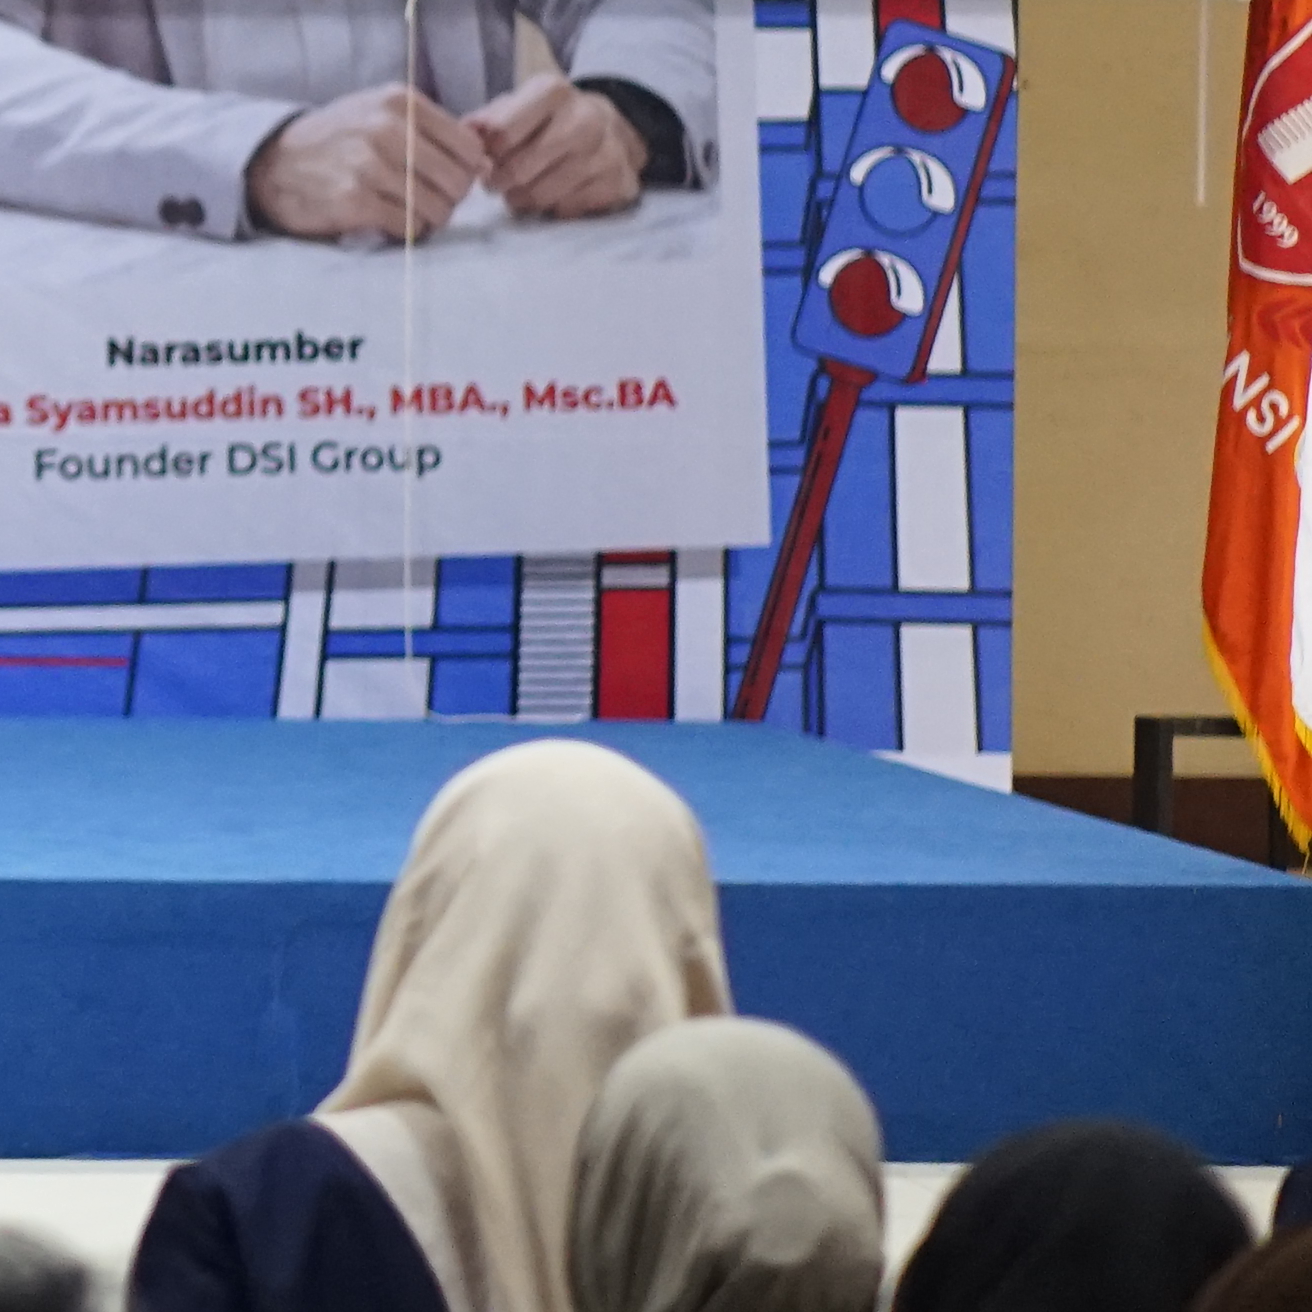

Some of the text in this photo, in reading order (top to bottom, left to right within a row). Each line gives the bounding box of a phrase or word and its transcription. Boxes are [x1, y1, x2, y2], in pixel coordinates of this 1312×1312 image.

[106, 331, 365, 370] Narasumber
[25, 383, 285, 435] Syamsuddin
[297, 386, 377, 424] SH.,
[389, 381, 509, 421] MBA.,
[522, 377, 678, 415] Msc.BA
[32, 439, 444, 485] Founder DSI Group
